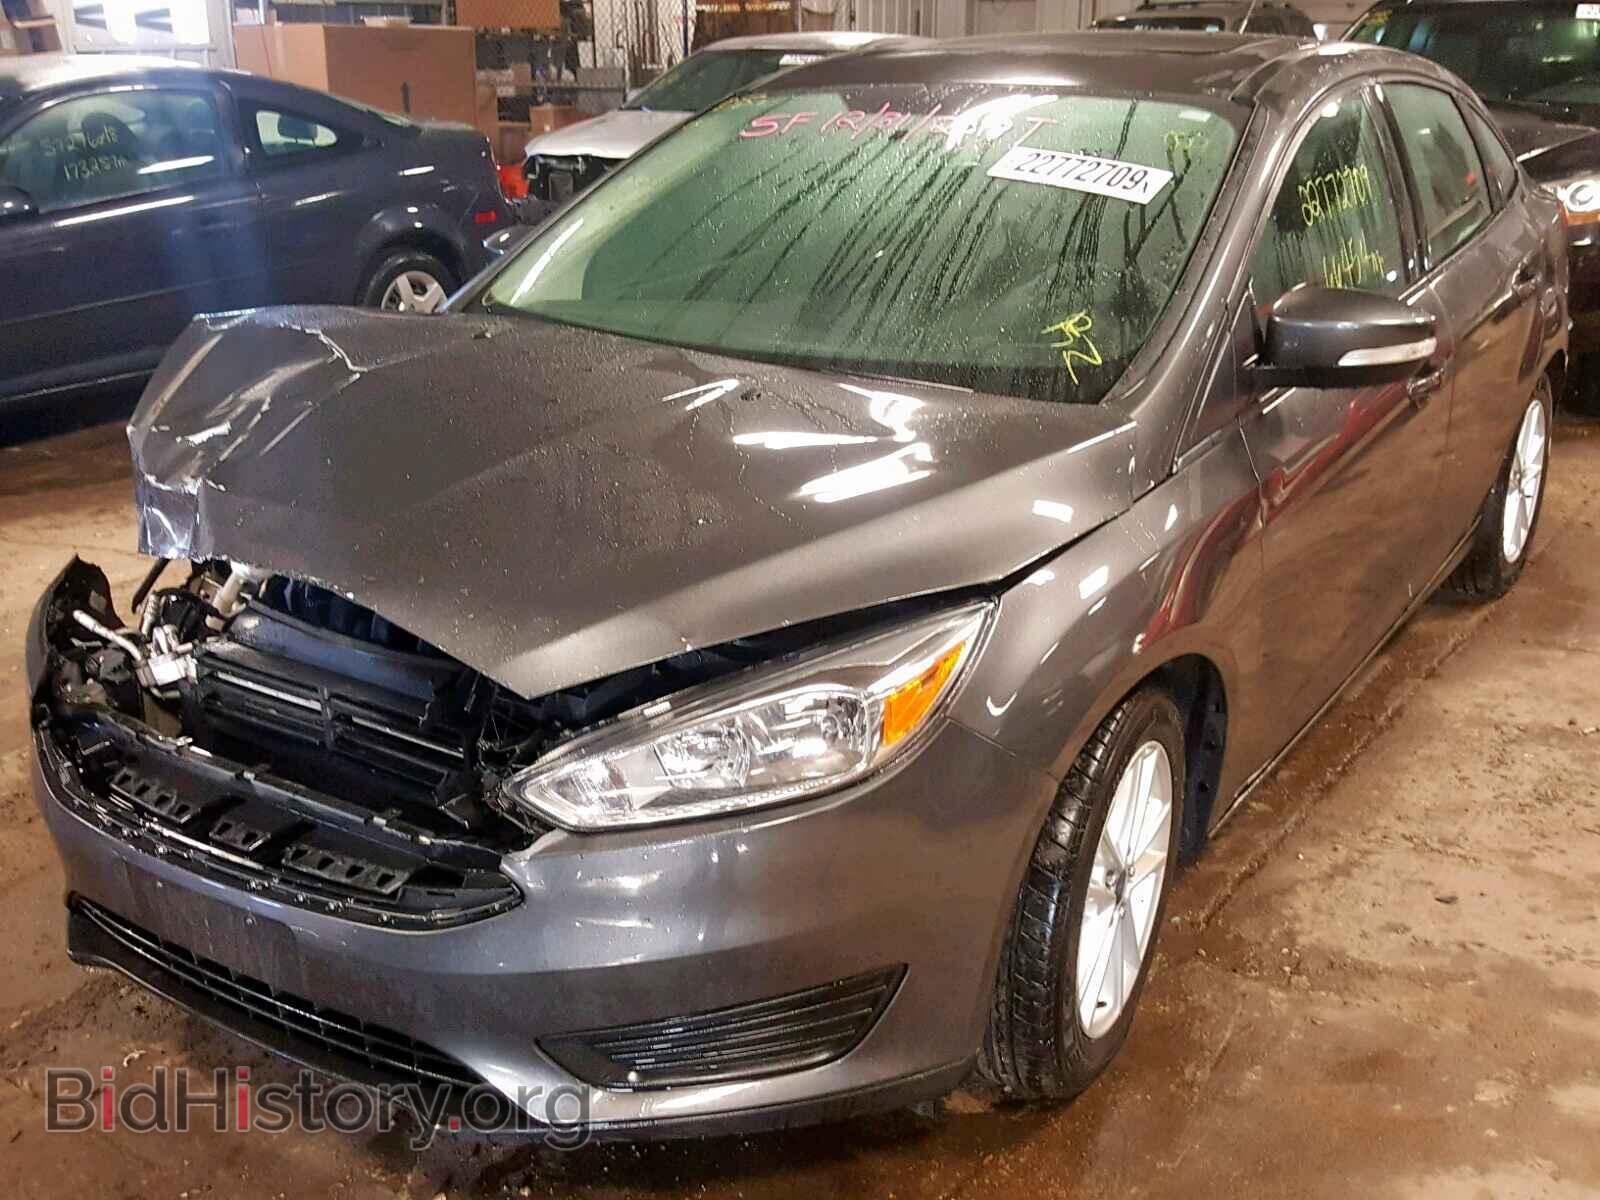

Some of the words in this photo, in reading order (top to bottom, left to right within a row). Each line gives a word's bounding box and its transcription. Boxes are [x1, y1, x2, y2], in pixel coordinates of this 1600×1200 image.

[739, 111, 818, 138] SF
[1013, 152, 1149, 191] 22772709
[1297, 163, 1373, 227] 22772709
